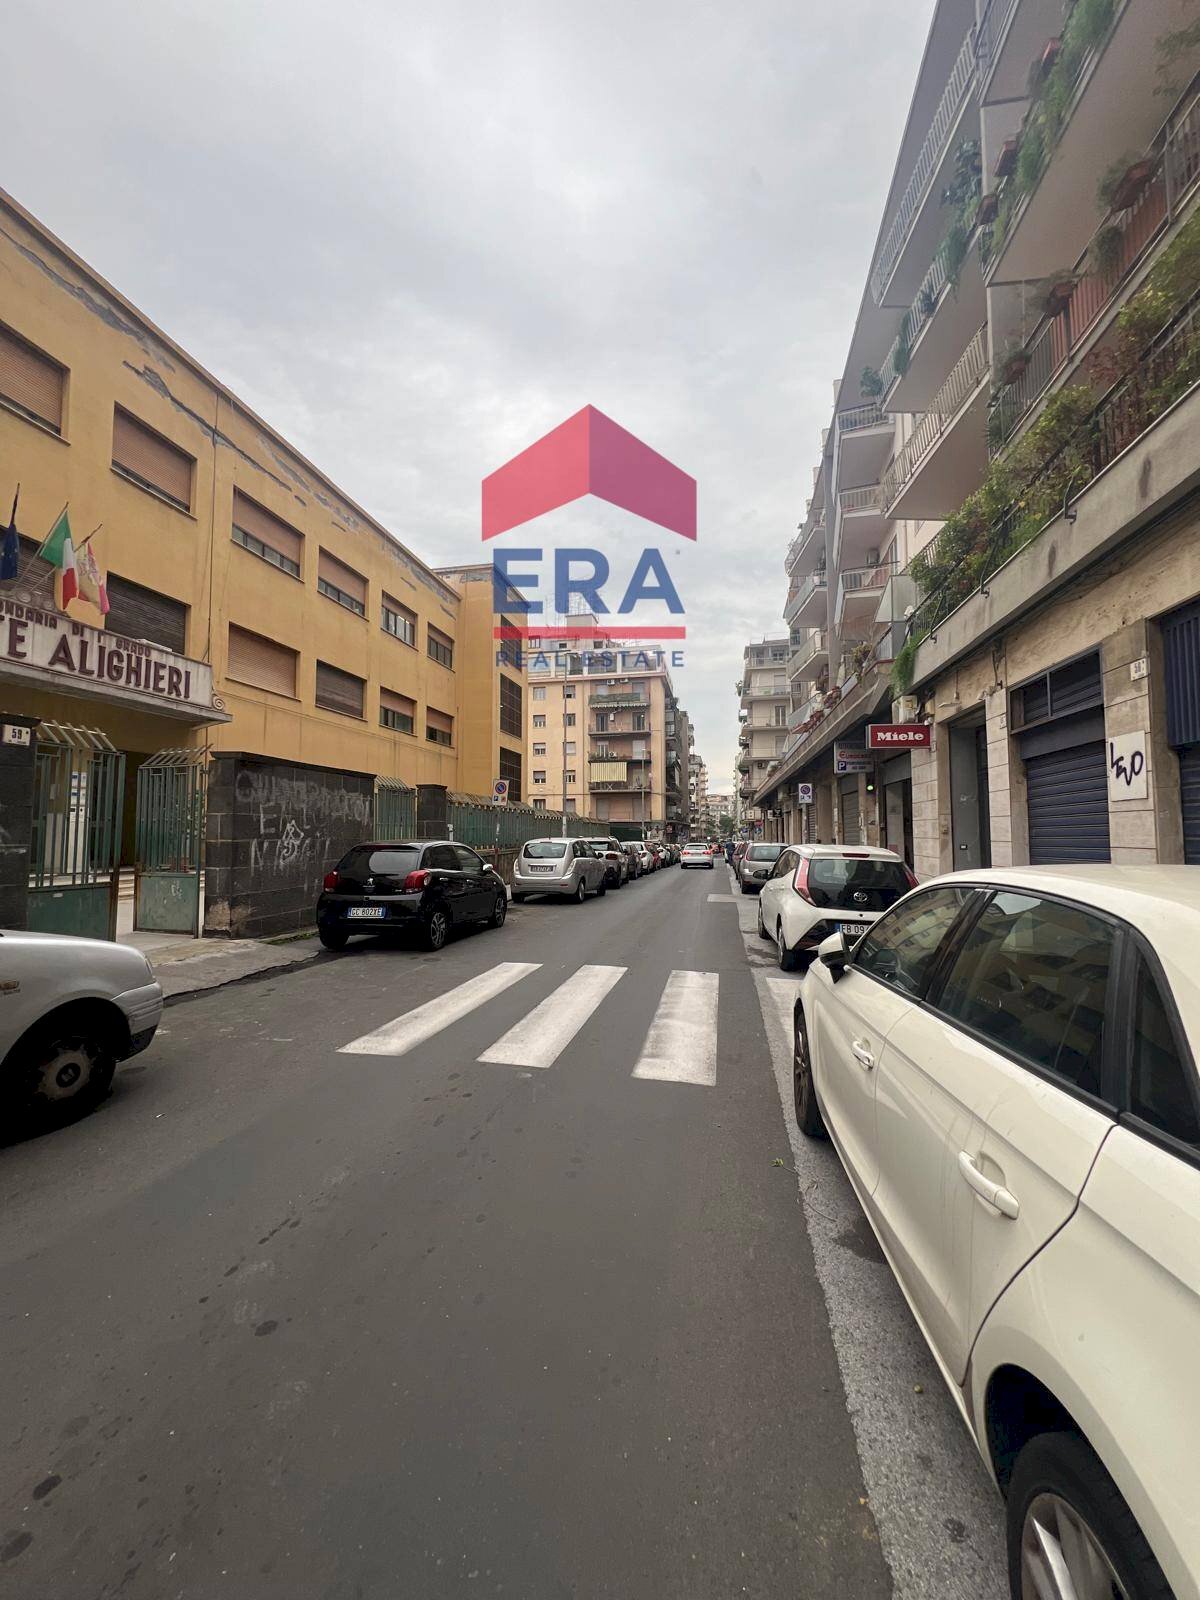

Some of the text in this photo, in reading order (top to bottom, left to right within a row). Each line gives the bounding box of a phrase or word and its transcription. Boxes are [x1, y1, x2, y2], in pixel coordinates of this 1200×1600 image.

[116, 637, 151, 657] GRADO
[48, 634, 191, 699] ALIGHIERI
[12, 728, 23, 740] 59
[877, 732, 924, 741] Miele
